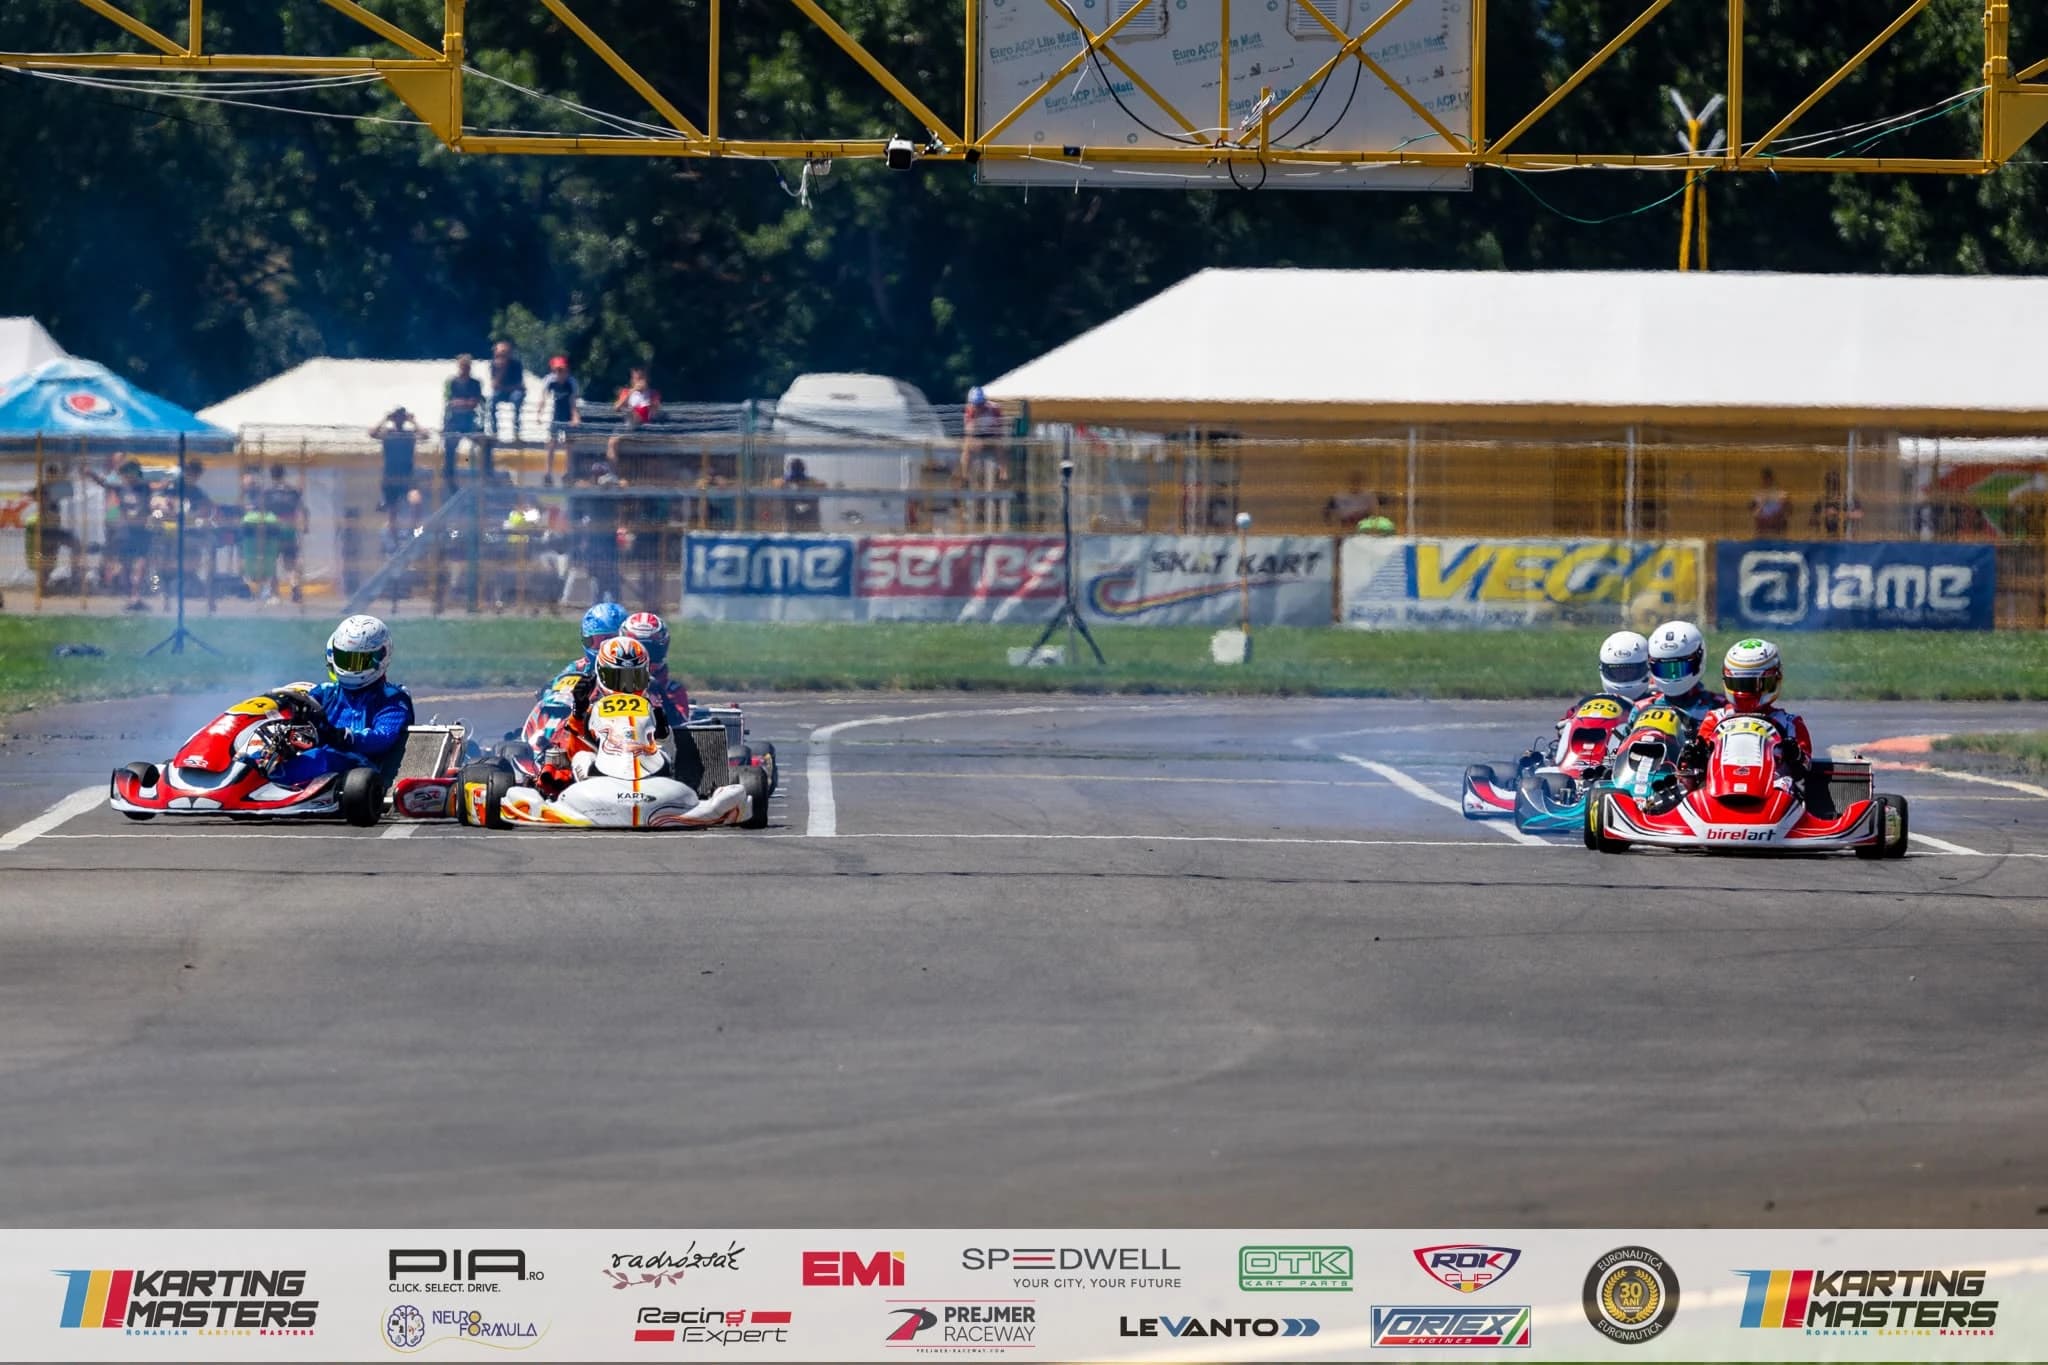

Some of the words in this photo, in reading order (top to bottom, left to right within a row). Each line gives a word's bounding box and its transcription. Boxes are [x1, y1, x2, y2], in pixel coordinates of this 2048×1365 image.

[1172, 47, 1195, 60] Euro
[1235, 552, 1321, 576] KART
[1412, 543, 1702, 602] VEGA
[602, 698, 642, 713] 522
[1706, 828, 1777, 841] birelart
